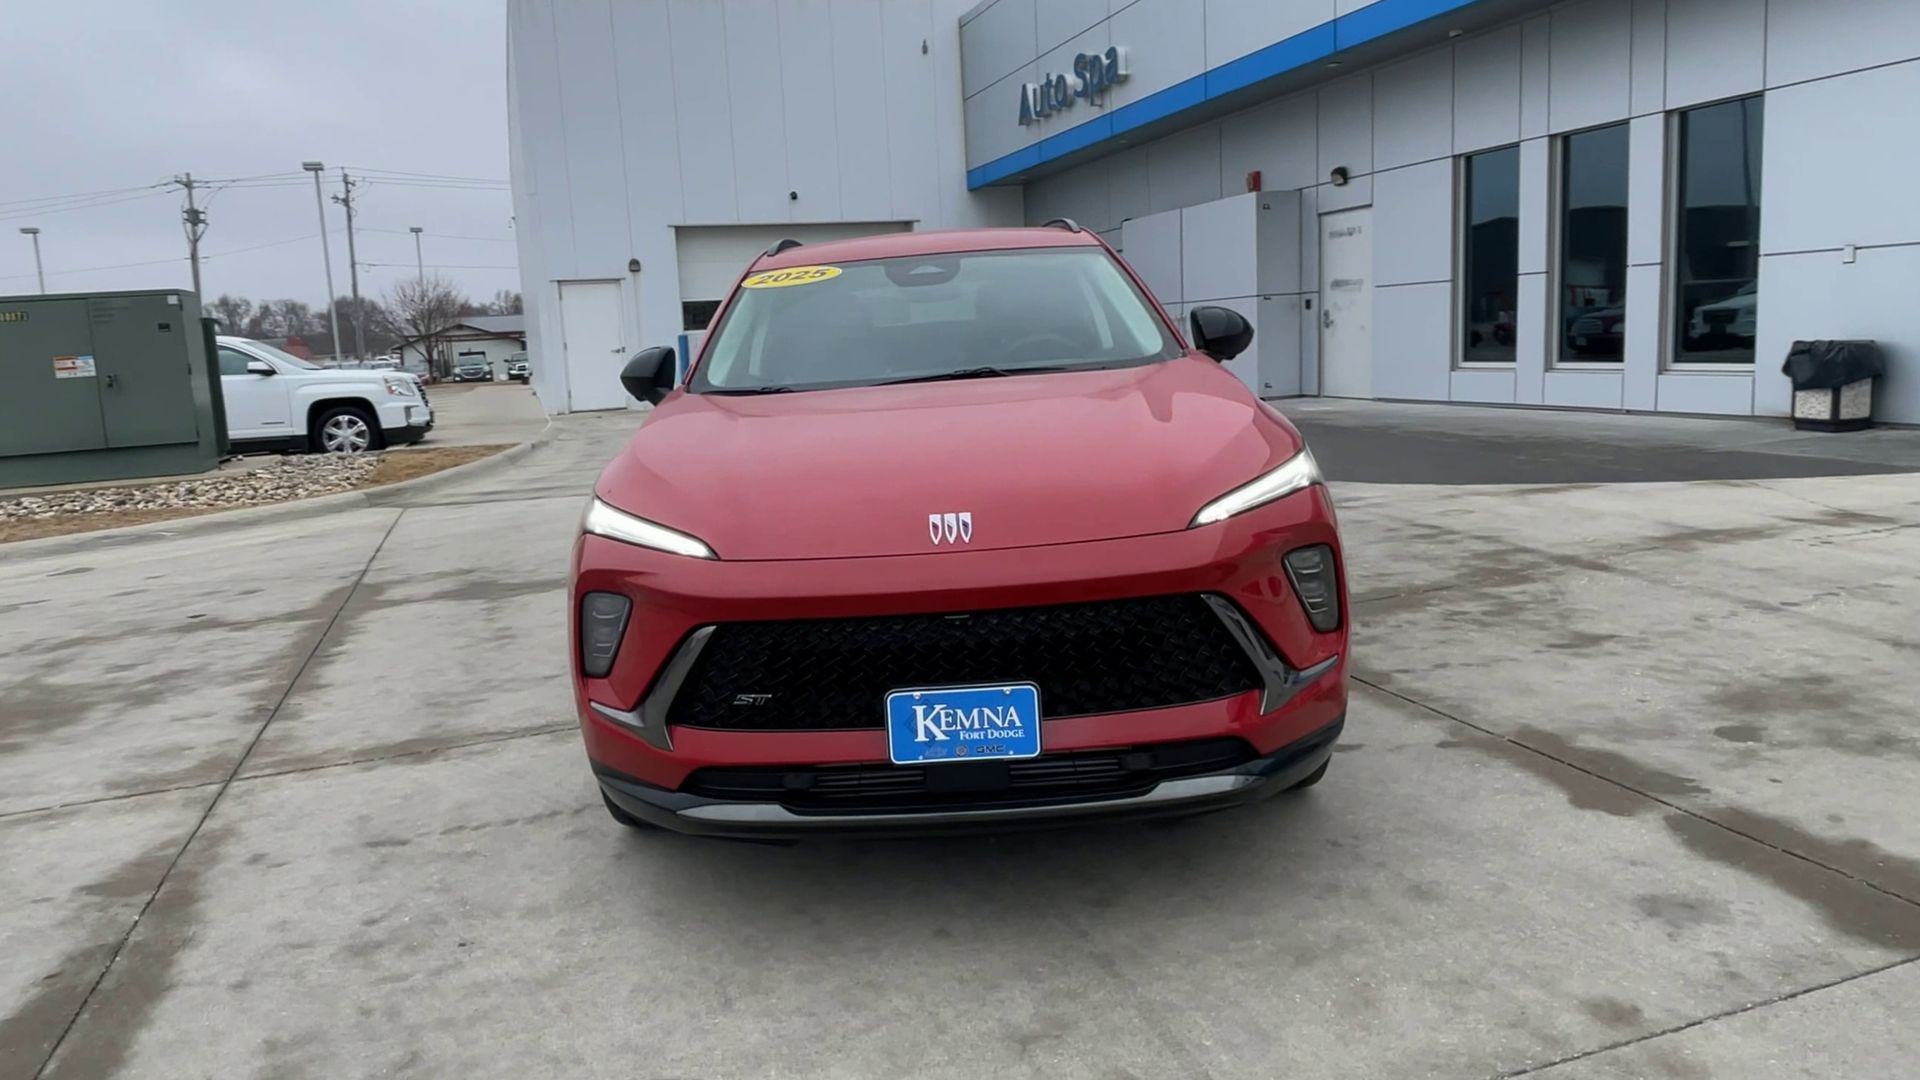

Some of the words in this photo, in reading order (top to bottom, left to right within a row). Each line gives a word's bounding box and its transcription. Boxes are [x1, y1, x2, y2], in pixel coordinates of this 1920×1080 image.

[1018, 73, 1074, 126] Auto
[1073, 46, 1125, 107] Spa
[753, 269, 829, 285] 2025
[733, 694, 772, 705] ST
[912, 704, 1023, 742] KEMNA
[959, 731, 986, 741] FORT
[987, 729, 1025, 739] DODGE
[976, 745, 1005, 753] GMC
